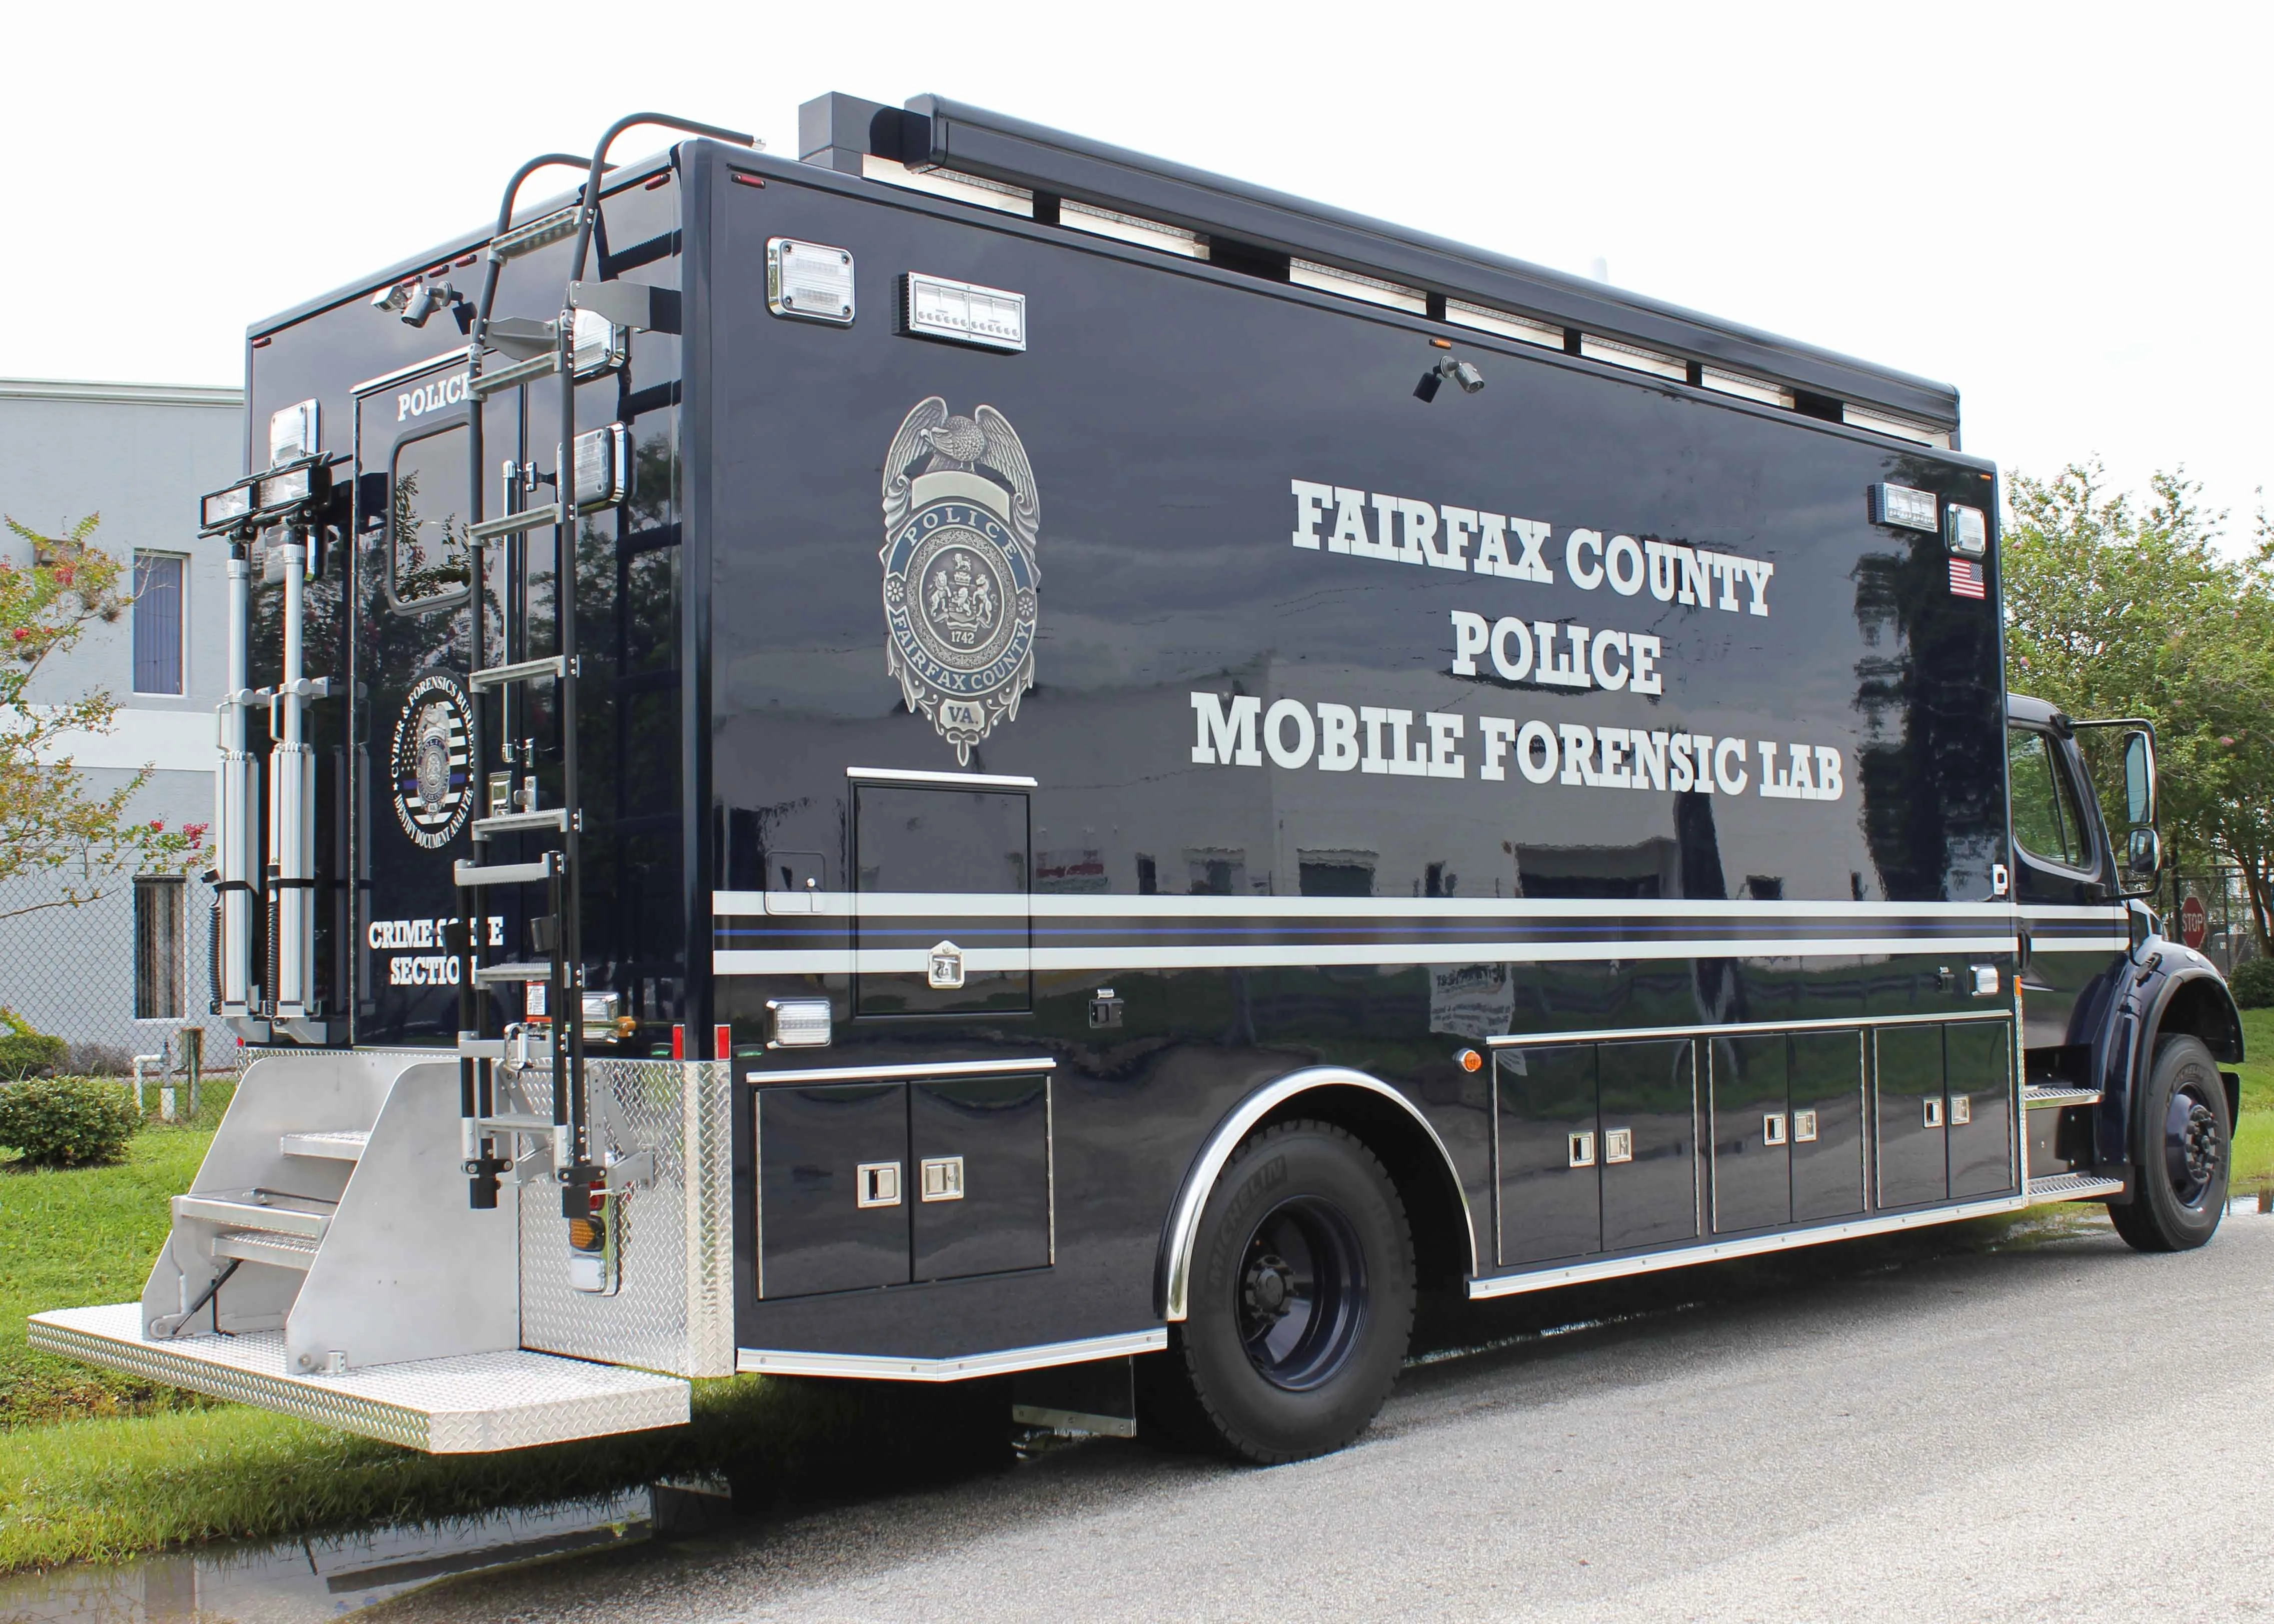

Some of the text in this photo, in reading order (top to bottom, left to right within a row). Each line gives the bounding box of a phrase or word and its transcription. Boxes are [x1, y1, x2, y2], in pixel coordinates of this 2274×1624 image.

[904, 507, 1017, 560] POLICE
[1291, 478, 1774, 617] FAIRFAX COUNTY
[893, 614, 1029, 690] FAIRFAX COUNTY
[951, 631, 975, 644] 1742
[1451, 610, 1661, 696] POLICE
[392, 720, 405, 778] CYBER
[408, 676, 458, 708] FORENSICS
[1191, 692, 1843, 801] MOBILE FORENSIC LAB
[415, 826, 451, 849] DOCUMENT
[369, 919, 433, 949] CRIME
[2182, 913, 2203, 932] STOP
